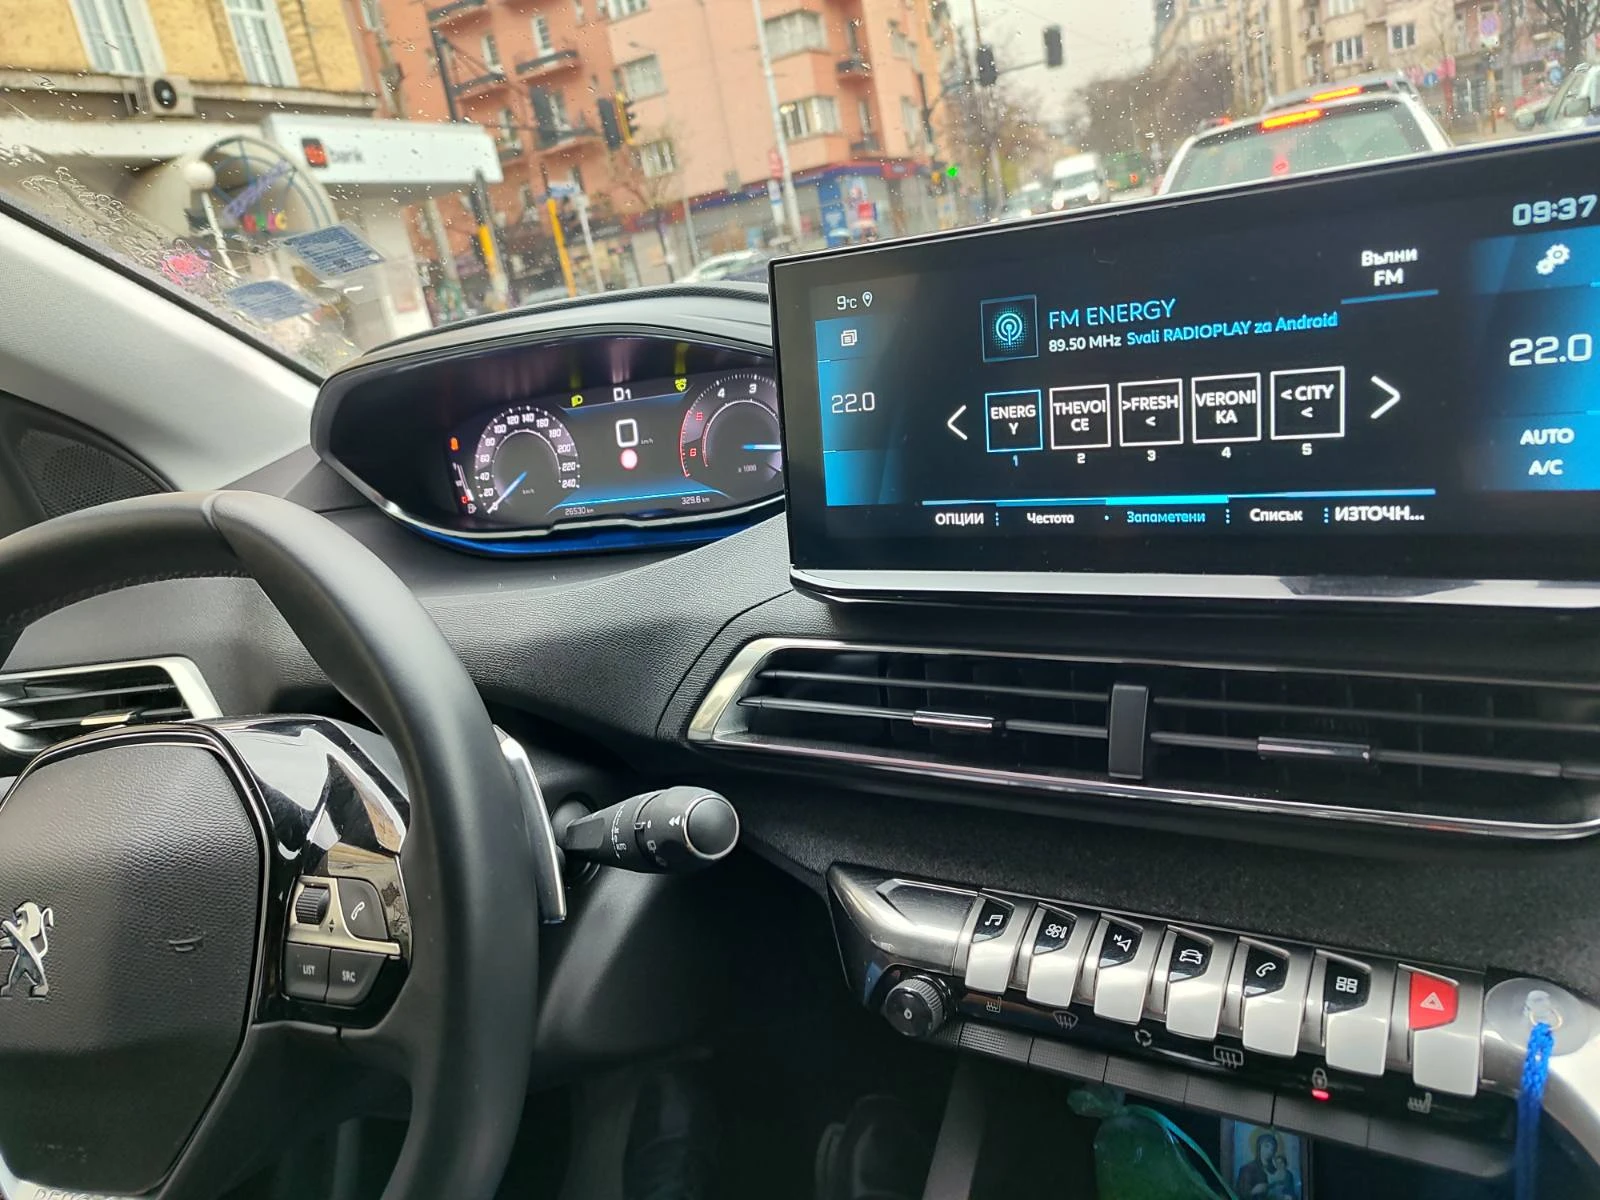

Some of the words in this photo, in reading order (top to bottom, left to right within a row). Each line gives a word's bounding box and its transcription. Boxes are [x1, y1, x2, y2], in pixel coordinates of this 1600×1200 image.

[1512, 194, 1598, 226] 09:37
[1361, 248, 1418, 267] Вълни
[1374, 268, 1404, 286] FM
[1049, 306, 1079, 330] FM
[1087, 298, 1176, 326] ENERGY
[1049, 336, 1086, 353] 89.50
[1089, 334, 1122, 350] MHz
[1127, 330, 1160, 346] Svali
[1164, 320, 1252, 343] RADIOPLAY
[1254, 322, 1272, 334] za
[1275, 311, 1337, 332] Android
[1509, 333, 1592, 367] 22.0
[717, 388, 725, 398] 4
[749, 383, 757, 394] 3
[1295, 383, 1335, 401] CITY
[831, 392, 876, 414] 22.0
[1195, 388, 1257, 407] VERONI
[990, 404, 1036, 420] ENERG
[1053, 399, 1107, 416] THEVOI
[506, 415, 520, 425] 120
[521, 412, 535, 423] 140
[1215, 409, 1238, 425] KA
[493, 424, 507, 434] 100
[1009, 422, 1020, 436] Y
[1070, 417, 1090, 432] CE
[615, 418, 639, 448] 0
[1519, 427, 1575, 446] AUTO
[557, 444, 571, 453] 200
[1221, 446, 1232, 459] 4
[1302, 443, 1313, 456] 5
[1012, 455, 1019, 467] 1
[1077, 452, 1086, 464] 2
[1147, 450, 1157, 462] 3
[561, 462, 576, 472] 220
[1527, 458, 1564, 476] A/C
[561, 479, 576, 489] 240
[935, 512, 985, 526] ОПЦИИ
[1026, 511, 1076, 525] Честота
[1126, 510, 1206, 524] Запаметени
[1249, 507, 1304, 522] Списък
[302, 964, 316, 976] LIST
[341, 969, 356, 983] SRC
